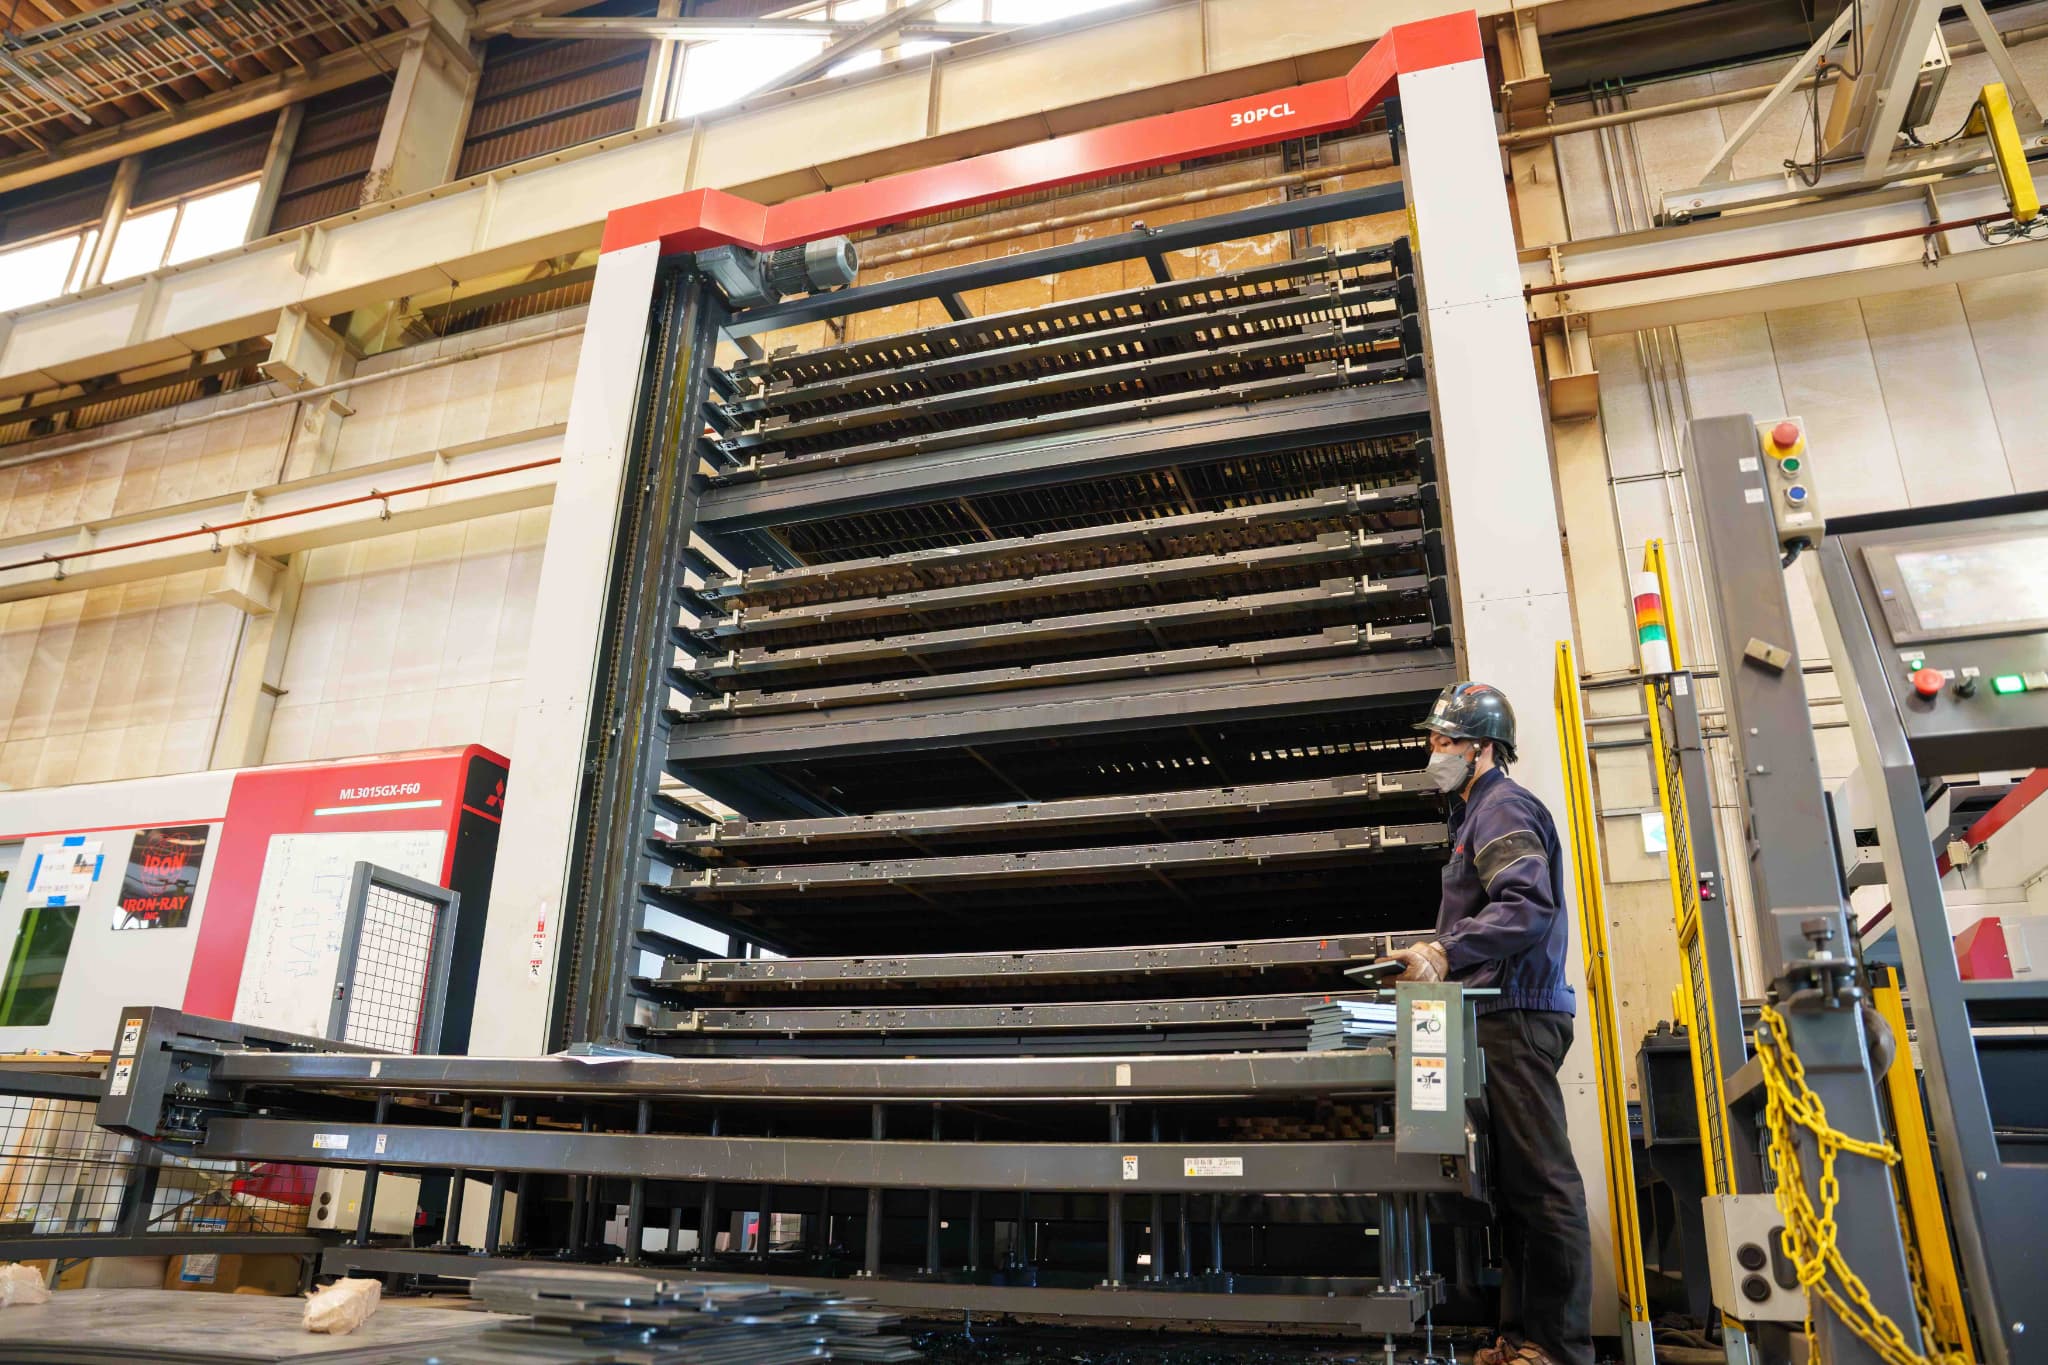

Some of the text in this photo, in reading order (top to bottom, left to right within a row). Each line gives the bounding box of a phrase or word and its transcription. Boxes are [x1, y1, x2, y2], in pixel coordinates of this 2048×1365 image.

[1230, 102, 1296, 127] 30PCL
[791, 693, 798, 703] 7
[339, 782, 421, 800] ML3015GX-F60
[779, 824, 786, 836] 5
[143, 852, 188, 877] IRON
[775, 870, 782, 881] 4
[122, 895, 189, 913] IRON-RAY
[767, 965, 775, 977] 2
